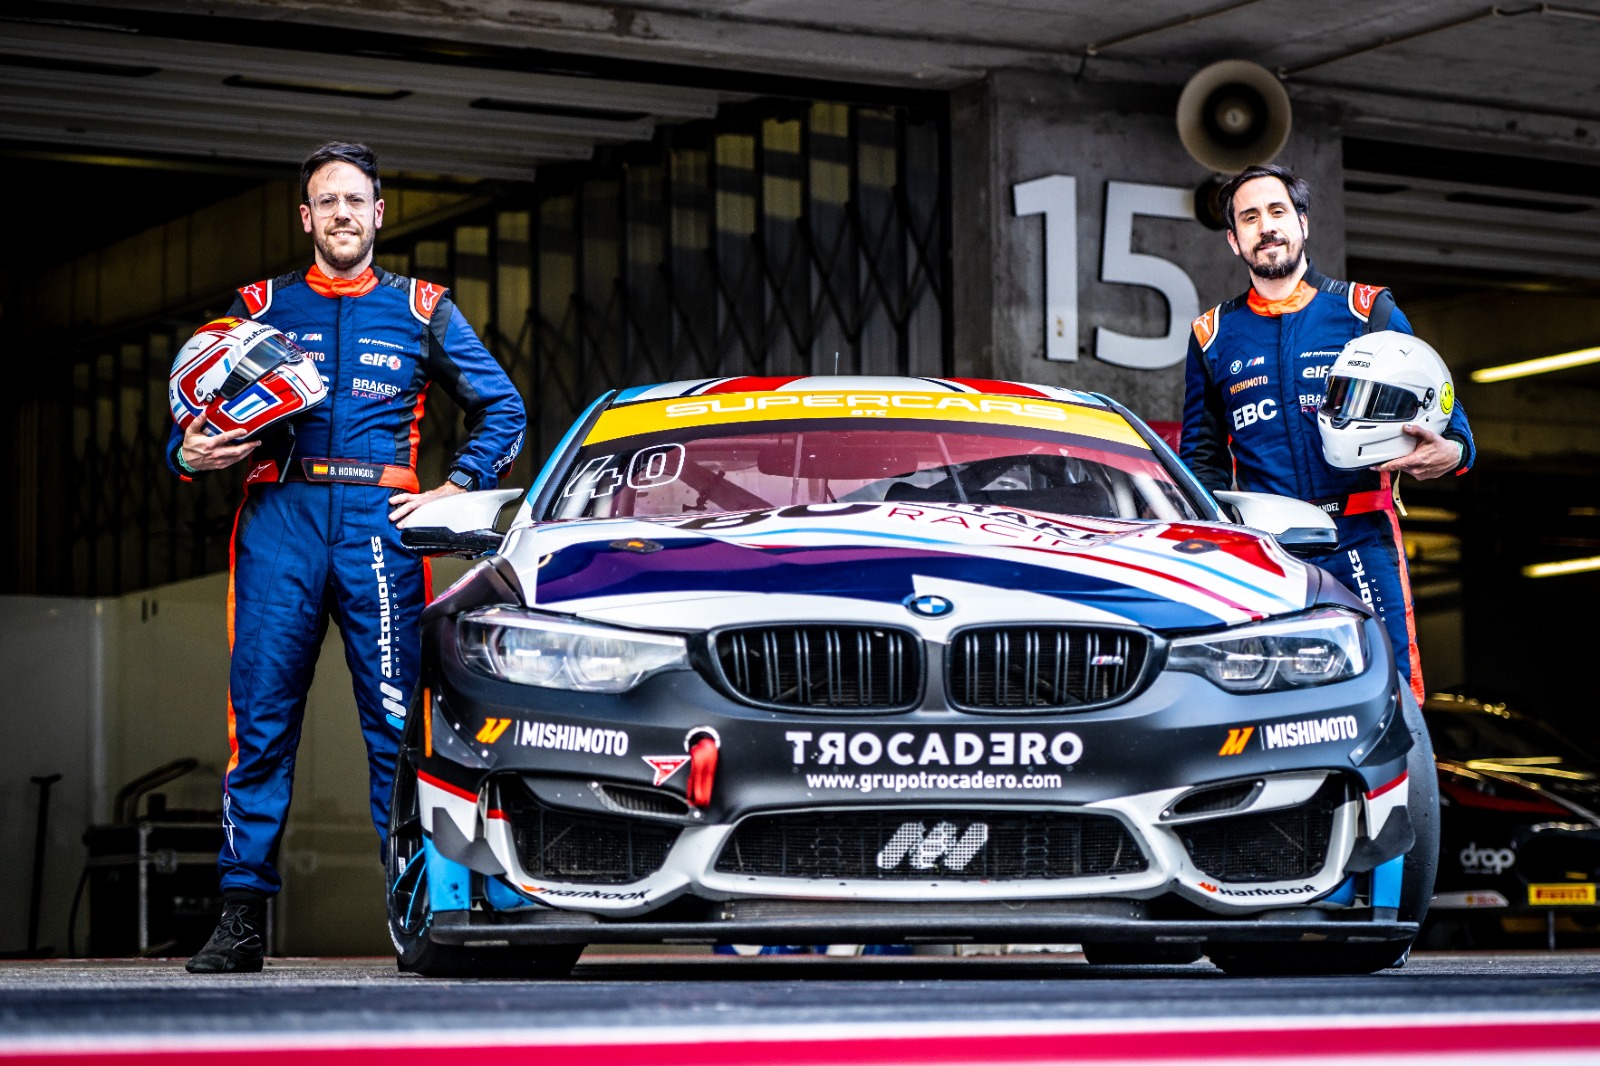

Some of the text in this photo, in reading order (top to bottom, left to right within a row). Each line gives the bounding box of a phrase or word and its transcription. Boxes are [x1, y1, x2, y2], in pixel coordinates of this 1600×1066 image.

[1012, 173, 1201, 370] 15
[359, 352, 388, 367] elf
[1302, 365, 1329, 378] elf
[1229, 375, 1269, 396] MISHIMOTO
[665, 394, 1067, 421] SUPERCARS
[1232, 398, 1278, 432] EBC
[329, 465, 374, 478] B. HORMIGOS
[563, 443, 686, 499] 40
[371, 536, 393, 679] autoworks
[521, 721, 630, 757] MISHIMOTO
[1265, 715, 1359, 750] MISHIMOTO
[806, 771, 1062, 793] www.grupotrocadero.com
[1460, 842, 1515, 875] drop
